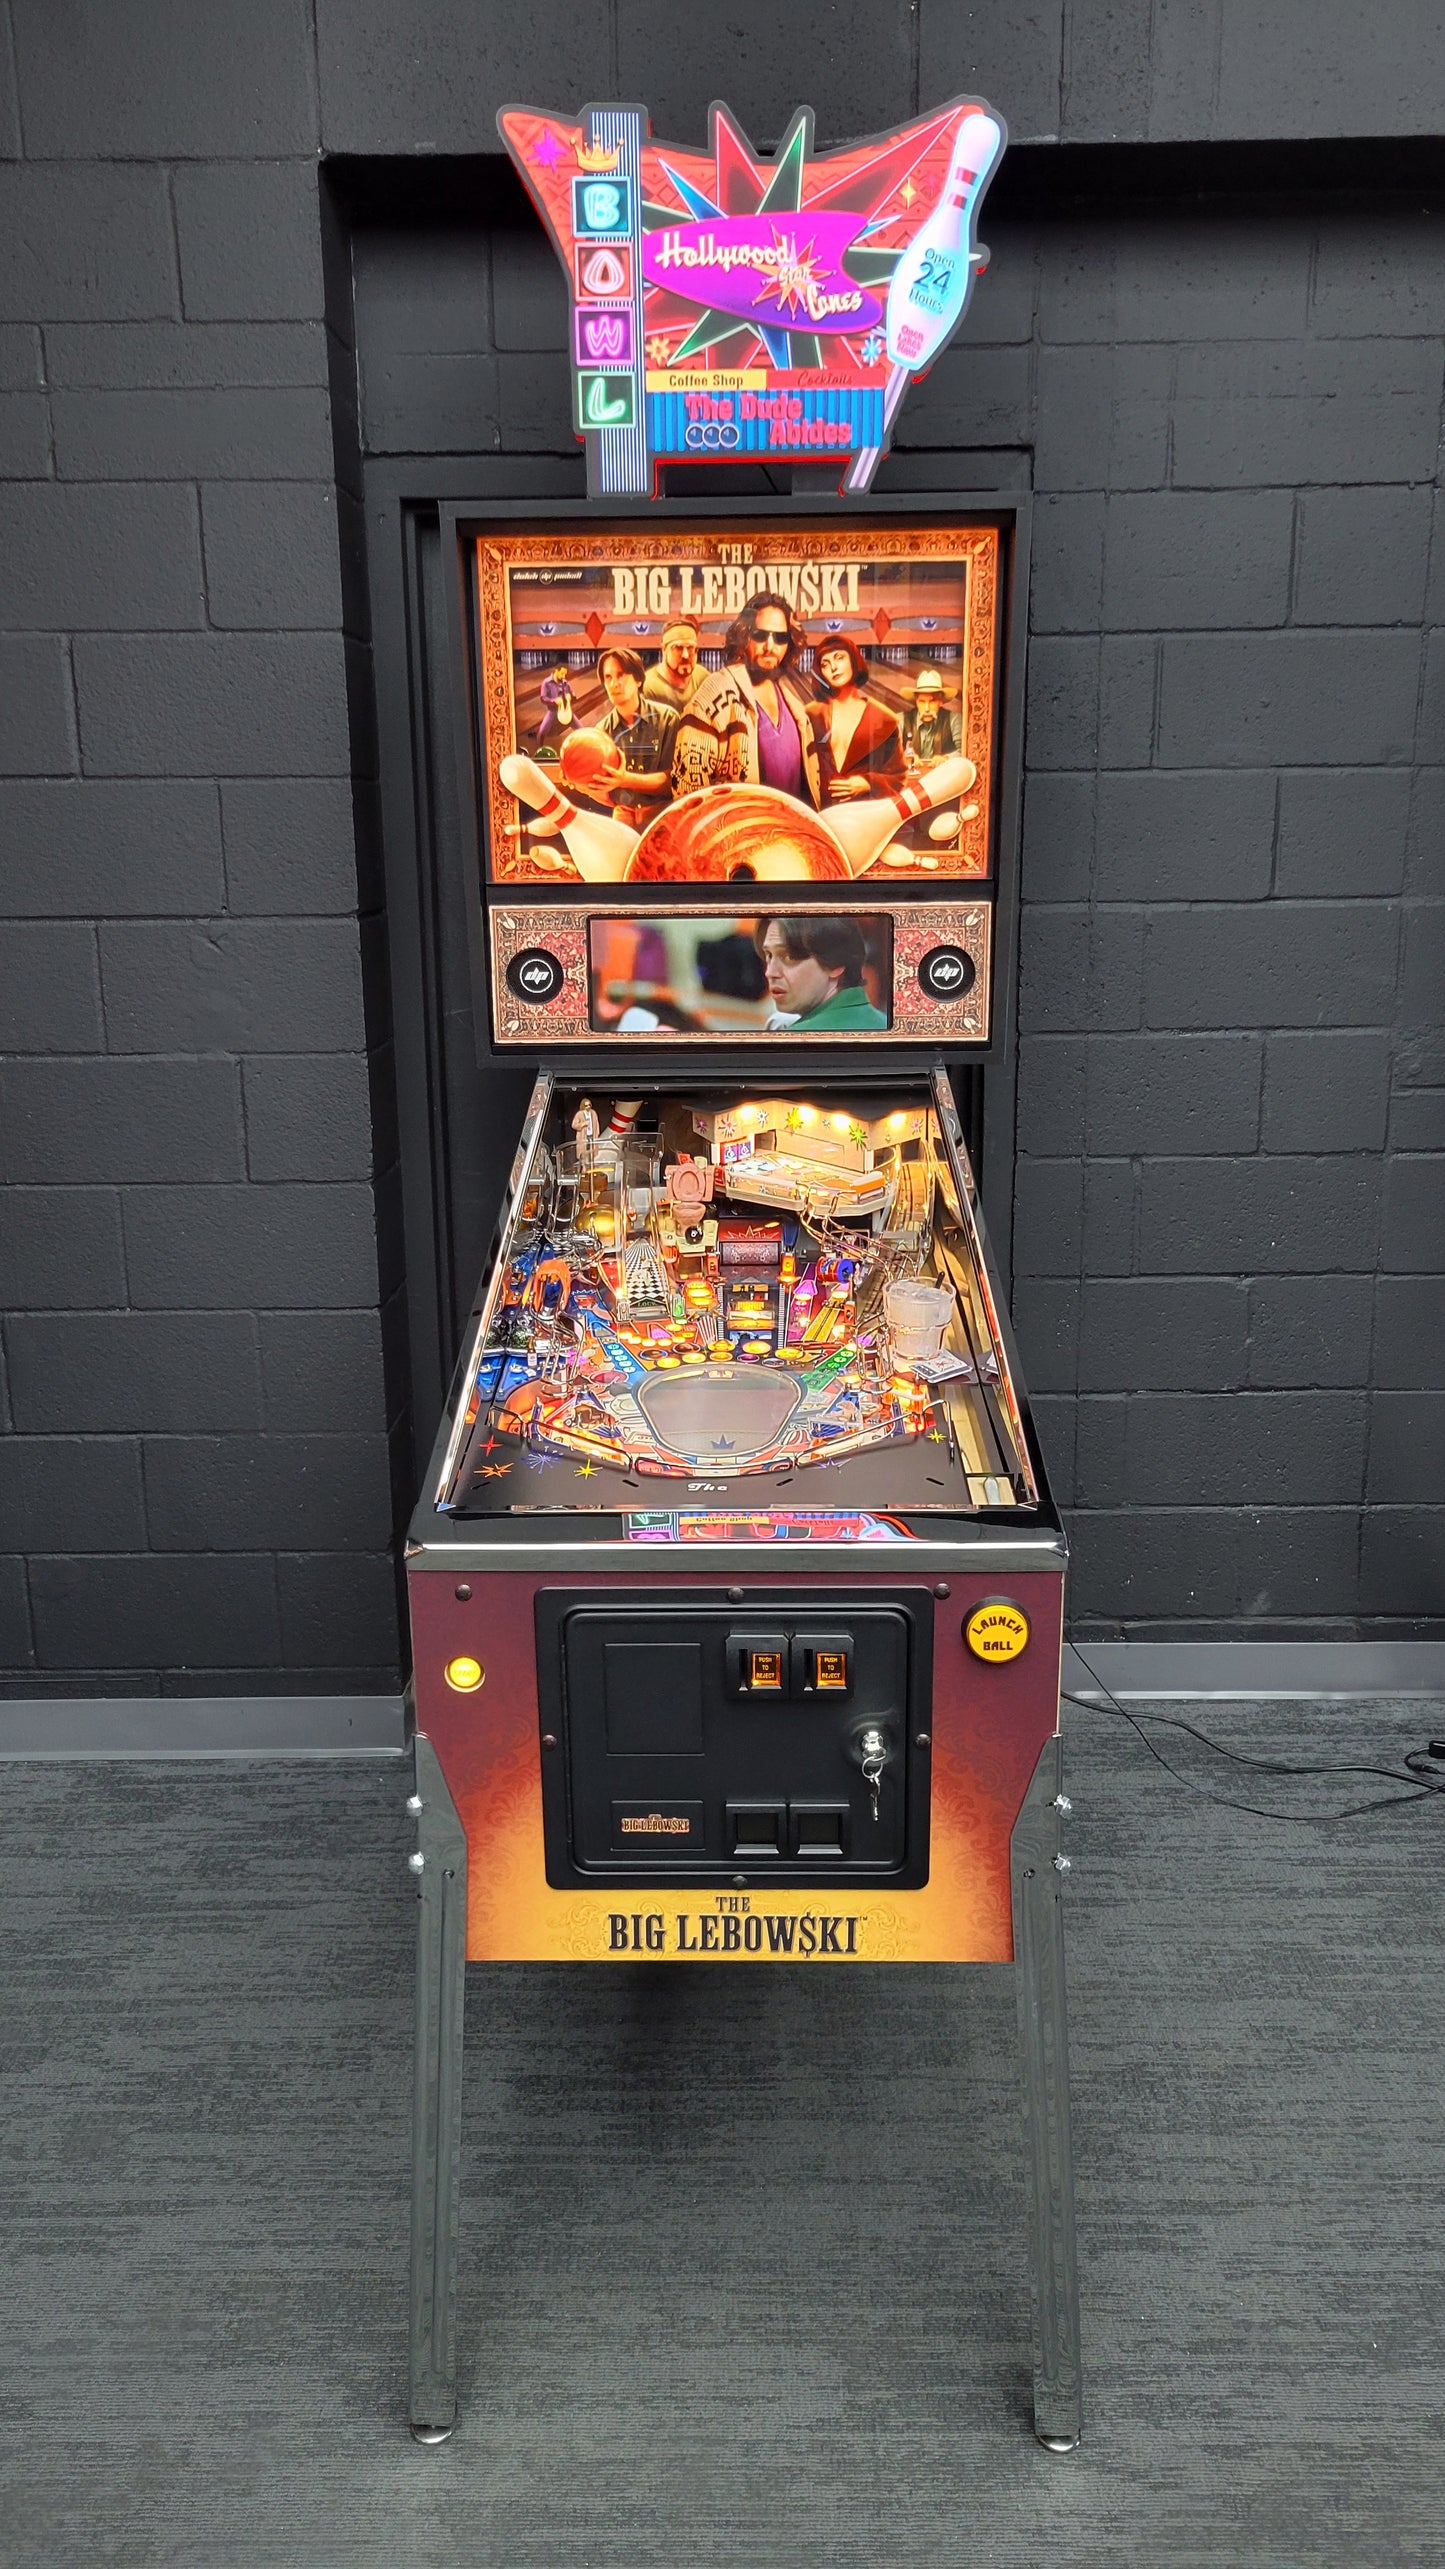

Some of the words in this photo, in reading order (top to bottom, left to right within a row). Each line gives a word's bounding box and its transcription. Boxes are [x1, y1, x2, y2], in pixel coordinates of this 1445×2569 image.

[655, 230, 792, 273] Hollywood
[925, 247, 956, 269] Open
[913, 261, 953, 295] 24
[909, 287, 944, 315] Hours
[669, 374, 707, 387] Coffee
[713, 374, 744, 389] Shop
[685, 394, 733, 421] The
[740, 393, 803, 419] Dude
[769, 418, 852, 444] Abides
[718, 543, 754, 565] THE
[612, 565, 672, 615] BIG
[687, 1482, 728, 1492] The
[972, 1616, 1024, 1635] LAUNCH
[983, 1641, 1013, 1651] BALL
[624, 1820, 639, 1830] BIG
[716, 1896, 750, 1912] THE
[608, 1914, 666, 1950] BIG
